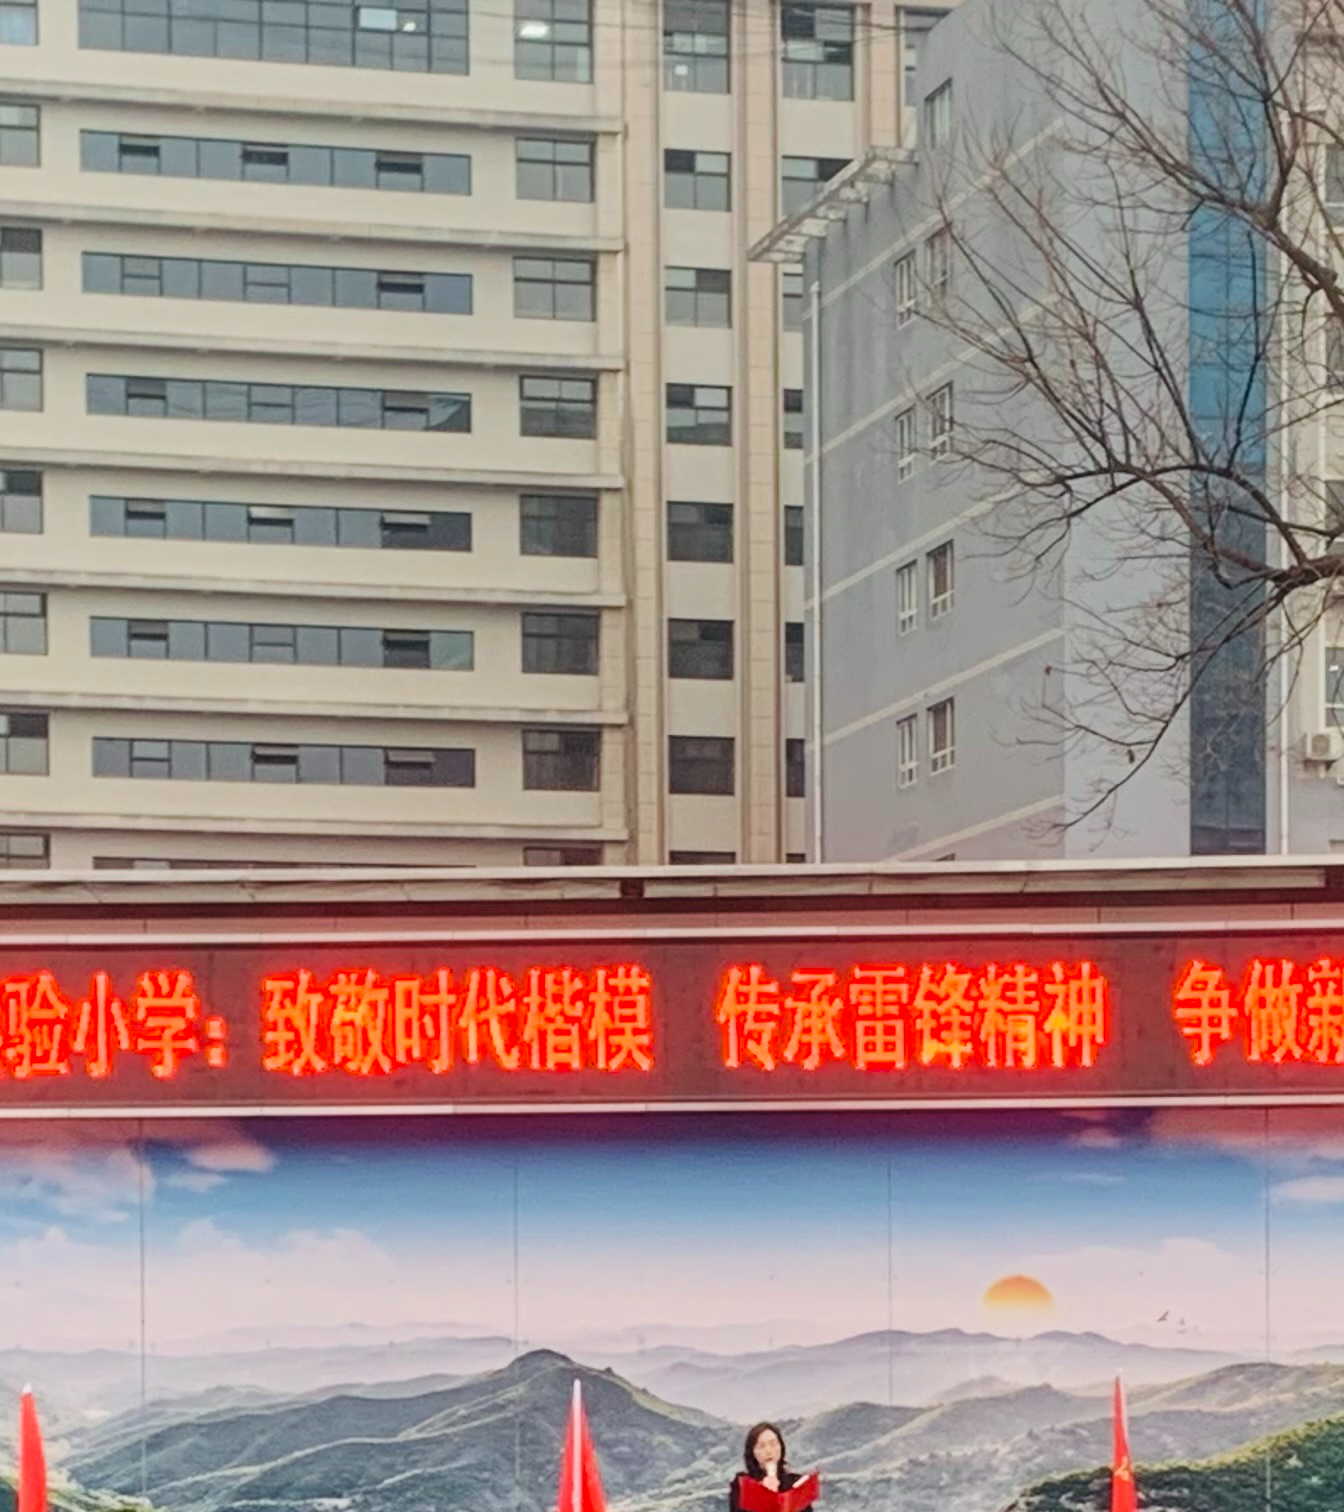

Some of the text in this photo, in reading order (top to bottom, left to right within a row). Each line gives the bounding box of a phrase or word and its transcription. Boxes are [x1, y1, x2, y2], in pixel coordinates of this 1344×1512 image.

[262, 967, 654, 1076] 致敬时代楷模
[717, 960, 1109, 1071] 传承雷锋精神
